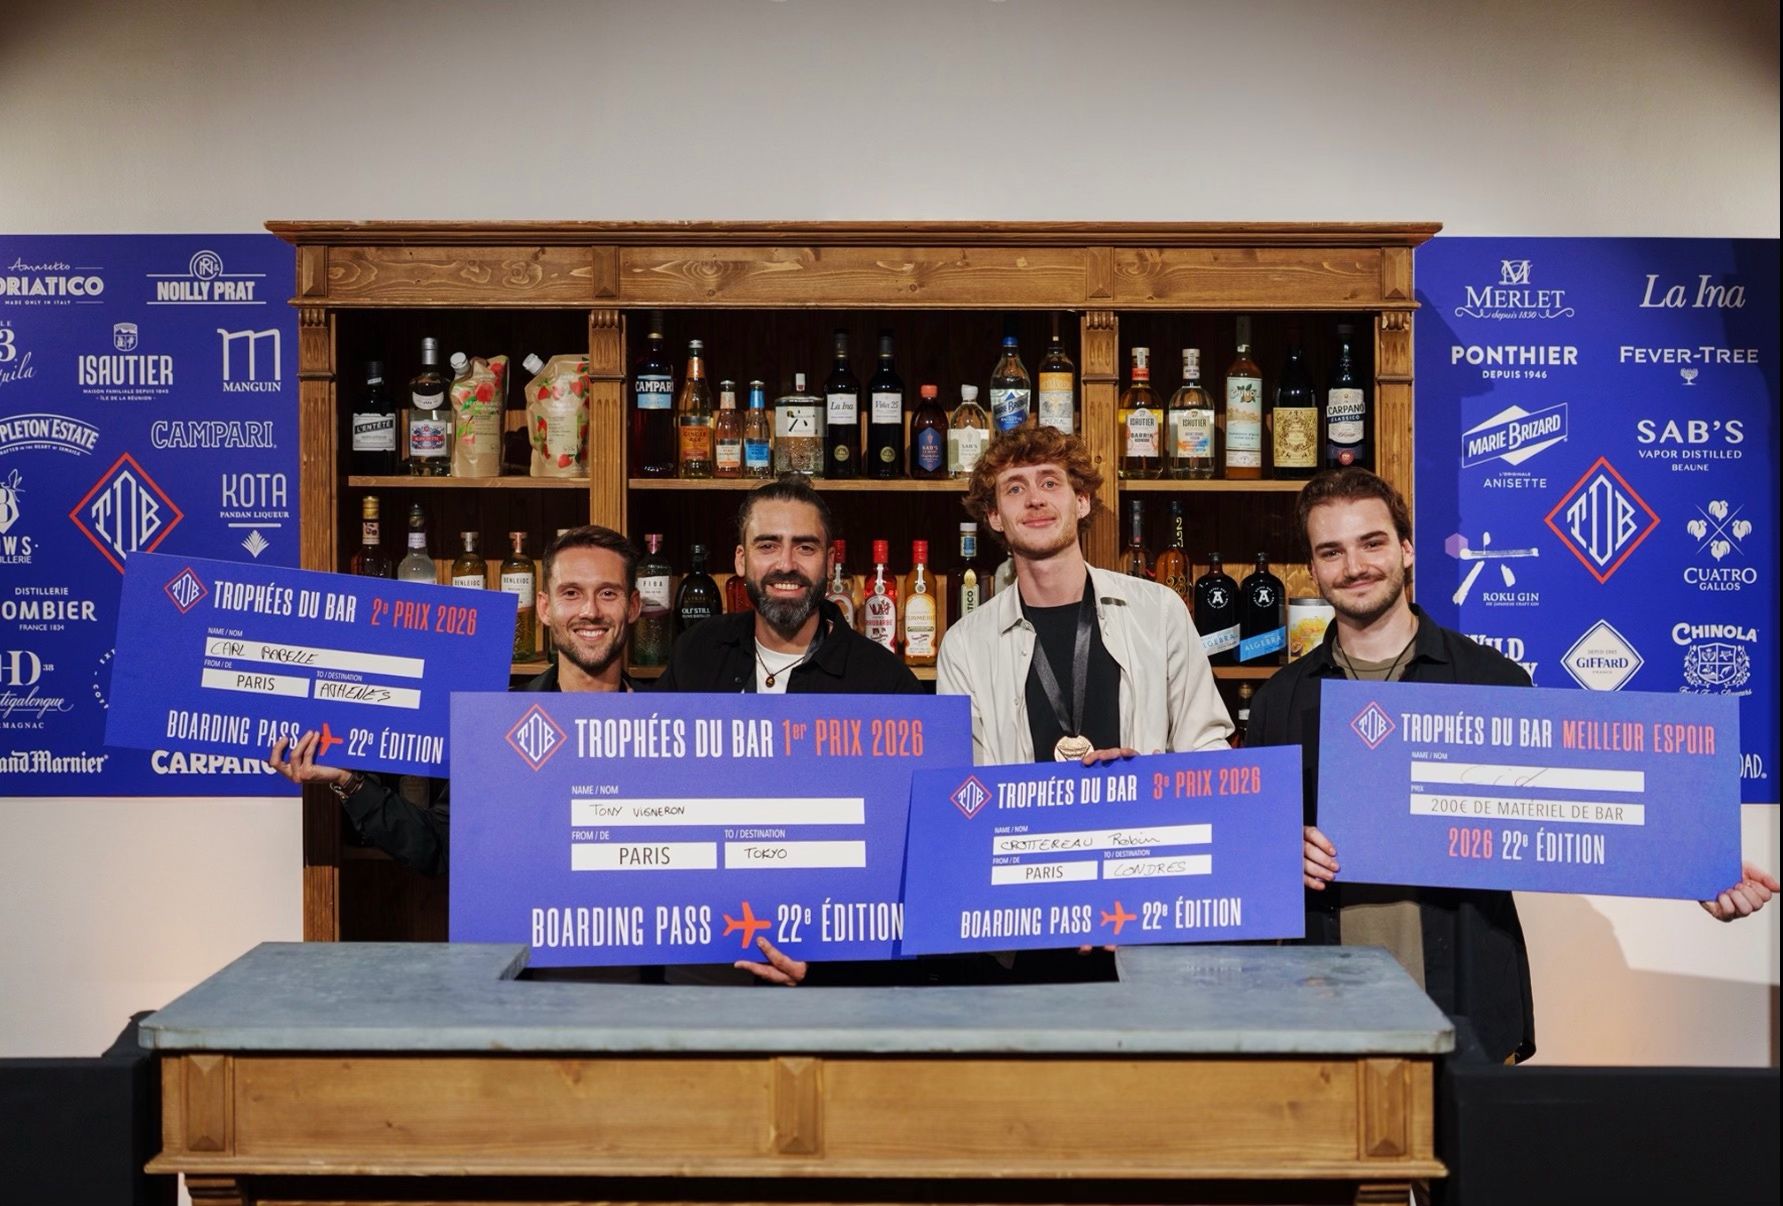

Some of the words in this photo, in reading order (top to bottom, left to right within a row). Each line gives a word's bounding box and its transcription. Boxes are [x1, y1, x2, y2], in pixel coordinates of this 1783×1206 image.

[8, 257, 71, 272] Amaretto
[157, 281, 209, 301] NOILLY
[214, 281, 256, 301] PRAT
[1465, 286, 1565, 308] MERLET
[1640, 274, 1687, 308] La
[1692, 274, 1746, 308] Ina
[1492, 310, 1517, 320] depuis
[1451, 346, 1578, 365] PONTHIER
[1620, 346, 1759, 363] FEVER-TREE
[79, 355, 174, 385] ISAUTIER
[1482, 370, 1521, 379] DEPUIS
[1524, 370, 1547, 379] 1946
[223, 382, 281, 392] MANGUIN
[1328, 403, 1365, 415] CARPANO
[51, 420, 99, 450] ESTATE
[151, 421, 273, 448] CAMPARI
[1468, 430, 1507, 458] MARIE
[1509, 415, 1561, 449] BRIZARD
[1637, 420, 1744, 444] SAB'S
[1638, 450, 1678, 459] VAPOR
[1681, 450, 1742, 459] DISTILLED
[222, 473, 287, 507] KOTA
[1483, 479, 1547, 488] ANISETTE
[254, 511, 289, 519] LIQUEUR
[1683, 567, 1757, 584] CUATRO
[15, 587, 69, 595] DISTILLERIE
[1699, 583, 1741, 591] GALLOS
[1483, 592, 1515, 601] ROKU
[1517, 592, 1539, 601] GIN
[213, 581, 293, 617] TROPHÉES
[299, 589, 319, 618] DU
[325, 596, 356, 623] BAR
[393, 602, 430, 631] PRIX
[435, 606, 477, 636] 2026
[208, 627, 224, 635] NAME
[229, 629, 243, 637] NOM
[1672, 622, 1757, 645] CHINOLA
[204, 659, 220, 667] FROM
[236, 675, 275, 691] PARIS
[328, 672, 363, 682] DESTINATION
[166, 710, 250, 745] BOARDING
[257, 719, 300, 749] PASS
[379, 727, 443, 764] ÉDITION
[575, 713, 686, 758] TROPHÉES
[696, 719, 724, 758] DU
[732, 719, 774, 758] BAR
[816, 719, 862, 757] PRIX
[871, 719, 924, 757] 2026
[1401, 712, 1484, 746] TROPHÉES
[1491, 716, 1513, 745] DU
[1520, 718, 1552, 748] BAR
[1562, 720, 1644, 752] MEILLEUR
[1654, 724, 1716, 755] ESPOIR
[29, 750, 104, 773] Marnier
[572, 786, 594, 795] NAME
[600, 785, 618, 795] NOM
[997, 776, 1075, 809] TROPHÉES
[1081, 779, 1100, 804] DU
[1106, 775, 1137, 803] BAR
[1175, 770, 1212, 797] PRIX
[1219, 766, 1260, 795] 2026
[1431, 798, 1468, 813] 200€
[1473, 800, 1491, 814] DE
[1497, 799, 1566, 817] MATÉRIEL
[1571, 805, 1590, 819] DE
[1595, 806, 1624, 821] BAR
[572, 831, 594, 840] FROM
[600, 831, 610, 840] DE
[725, 830, 735, 838] TO
[740, 829, 785, 838] DESTINATION
[1115, 849, 1150, 857] DESTINATION
[1448, 828, 1493, 858] 2026
[1536, 827, 1605, 865] ÉDITION
[620, 847, 671, 865] PARIS
[992, 857, 1008, 865] FROM
[1026, 865, 1063, 880] PARIS
[532, 907, 643, 947] BOARDING
[656, 906, 712, 944] PASS
[821, 898, 904, 942] ÉDITION
[961, 908, 1041, 938] BOARDING
[1050, 905, 1091, 934] PASS
[1175, 896, 1241, 928] ÉDITION
